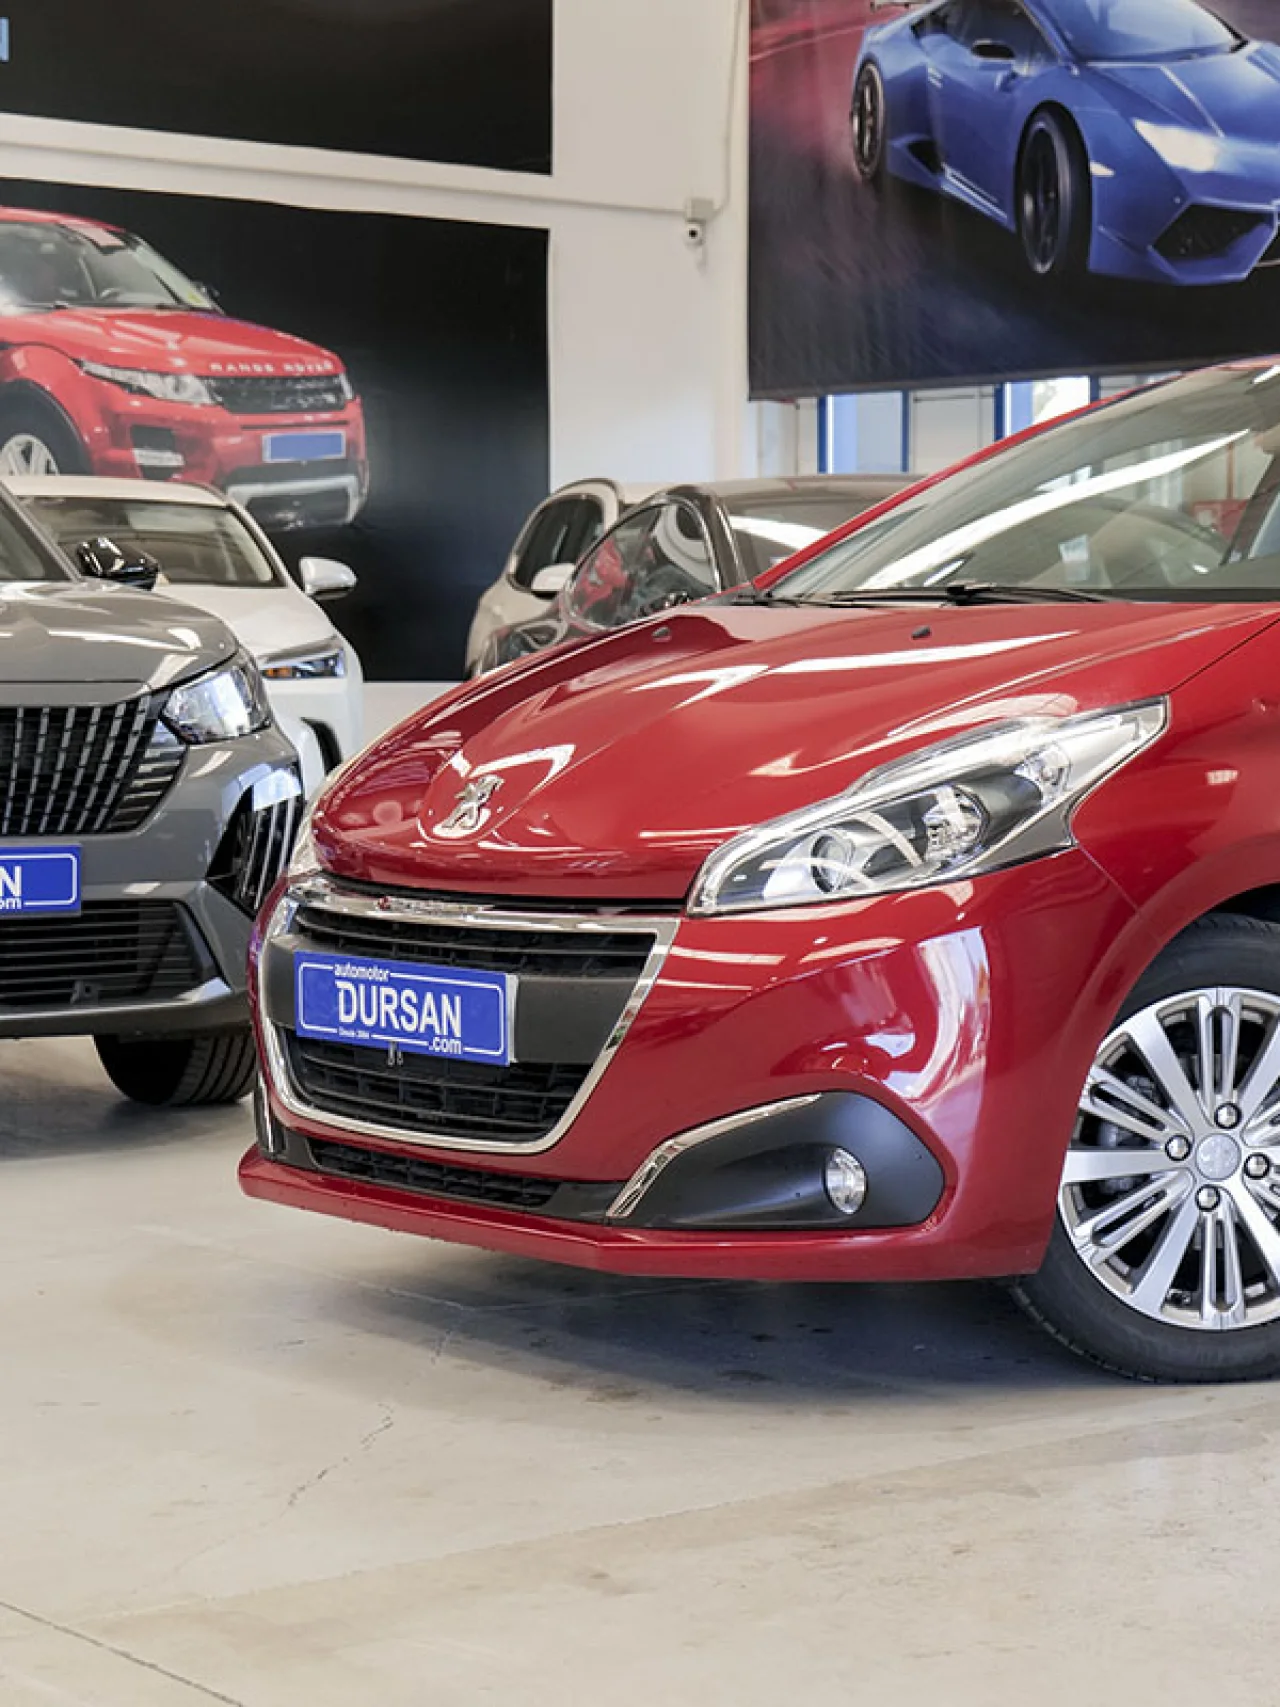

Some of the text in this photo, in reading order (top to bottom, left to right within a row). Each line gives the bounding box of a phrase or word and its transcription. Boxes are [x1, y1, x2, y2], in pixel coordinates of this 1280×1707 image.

[334, 963, 390, 982] automotor
[335, 980, 462, 1038] DURSAN
[428, 1036, 462, 1054] .com
